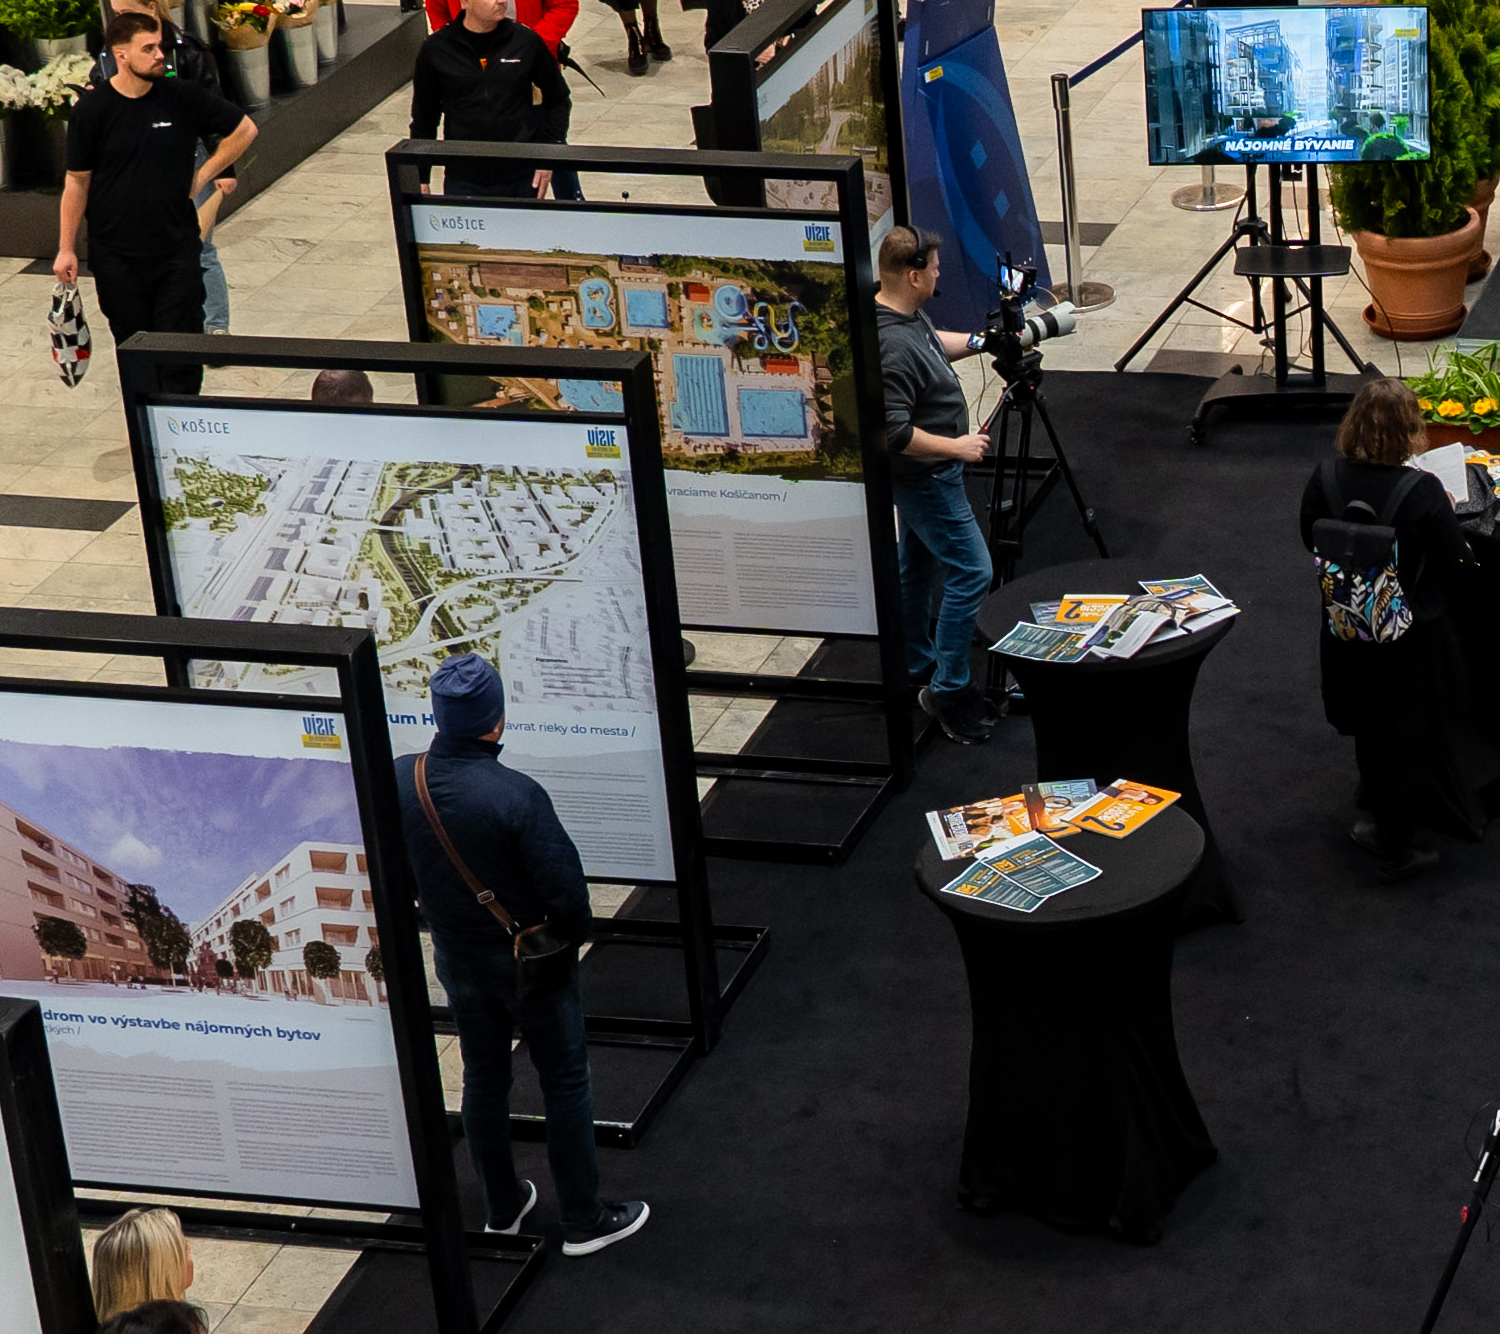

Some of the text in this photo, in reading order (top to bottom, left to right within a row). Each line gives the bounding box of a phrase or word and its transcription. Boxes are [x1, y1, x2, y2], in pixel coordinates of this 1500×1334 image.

[1225, 135, 1355, 152] NÁJOMNÉ BÝVANIE
[441, 216, 485, 231] KOŠICE
[181, 419, 231, 436] KOŠICE
[667, 485, 717, 498] vraciame
[505, 719, 536, 735] ávrat
[538, 723, 568, 740] rieky
[571, 723, 586, 736] do
[589, 725, 629, 738] mesta
[43, 1008, 321, 1042] drom vo výstavbe nájomných bytov
[45, 1023, 74, 1036] tkých
